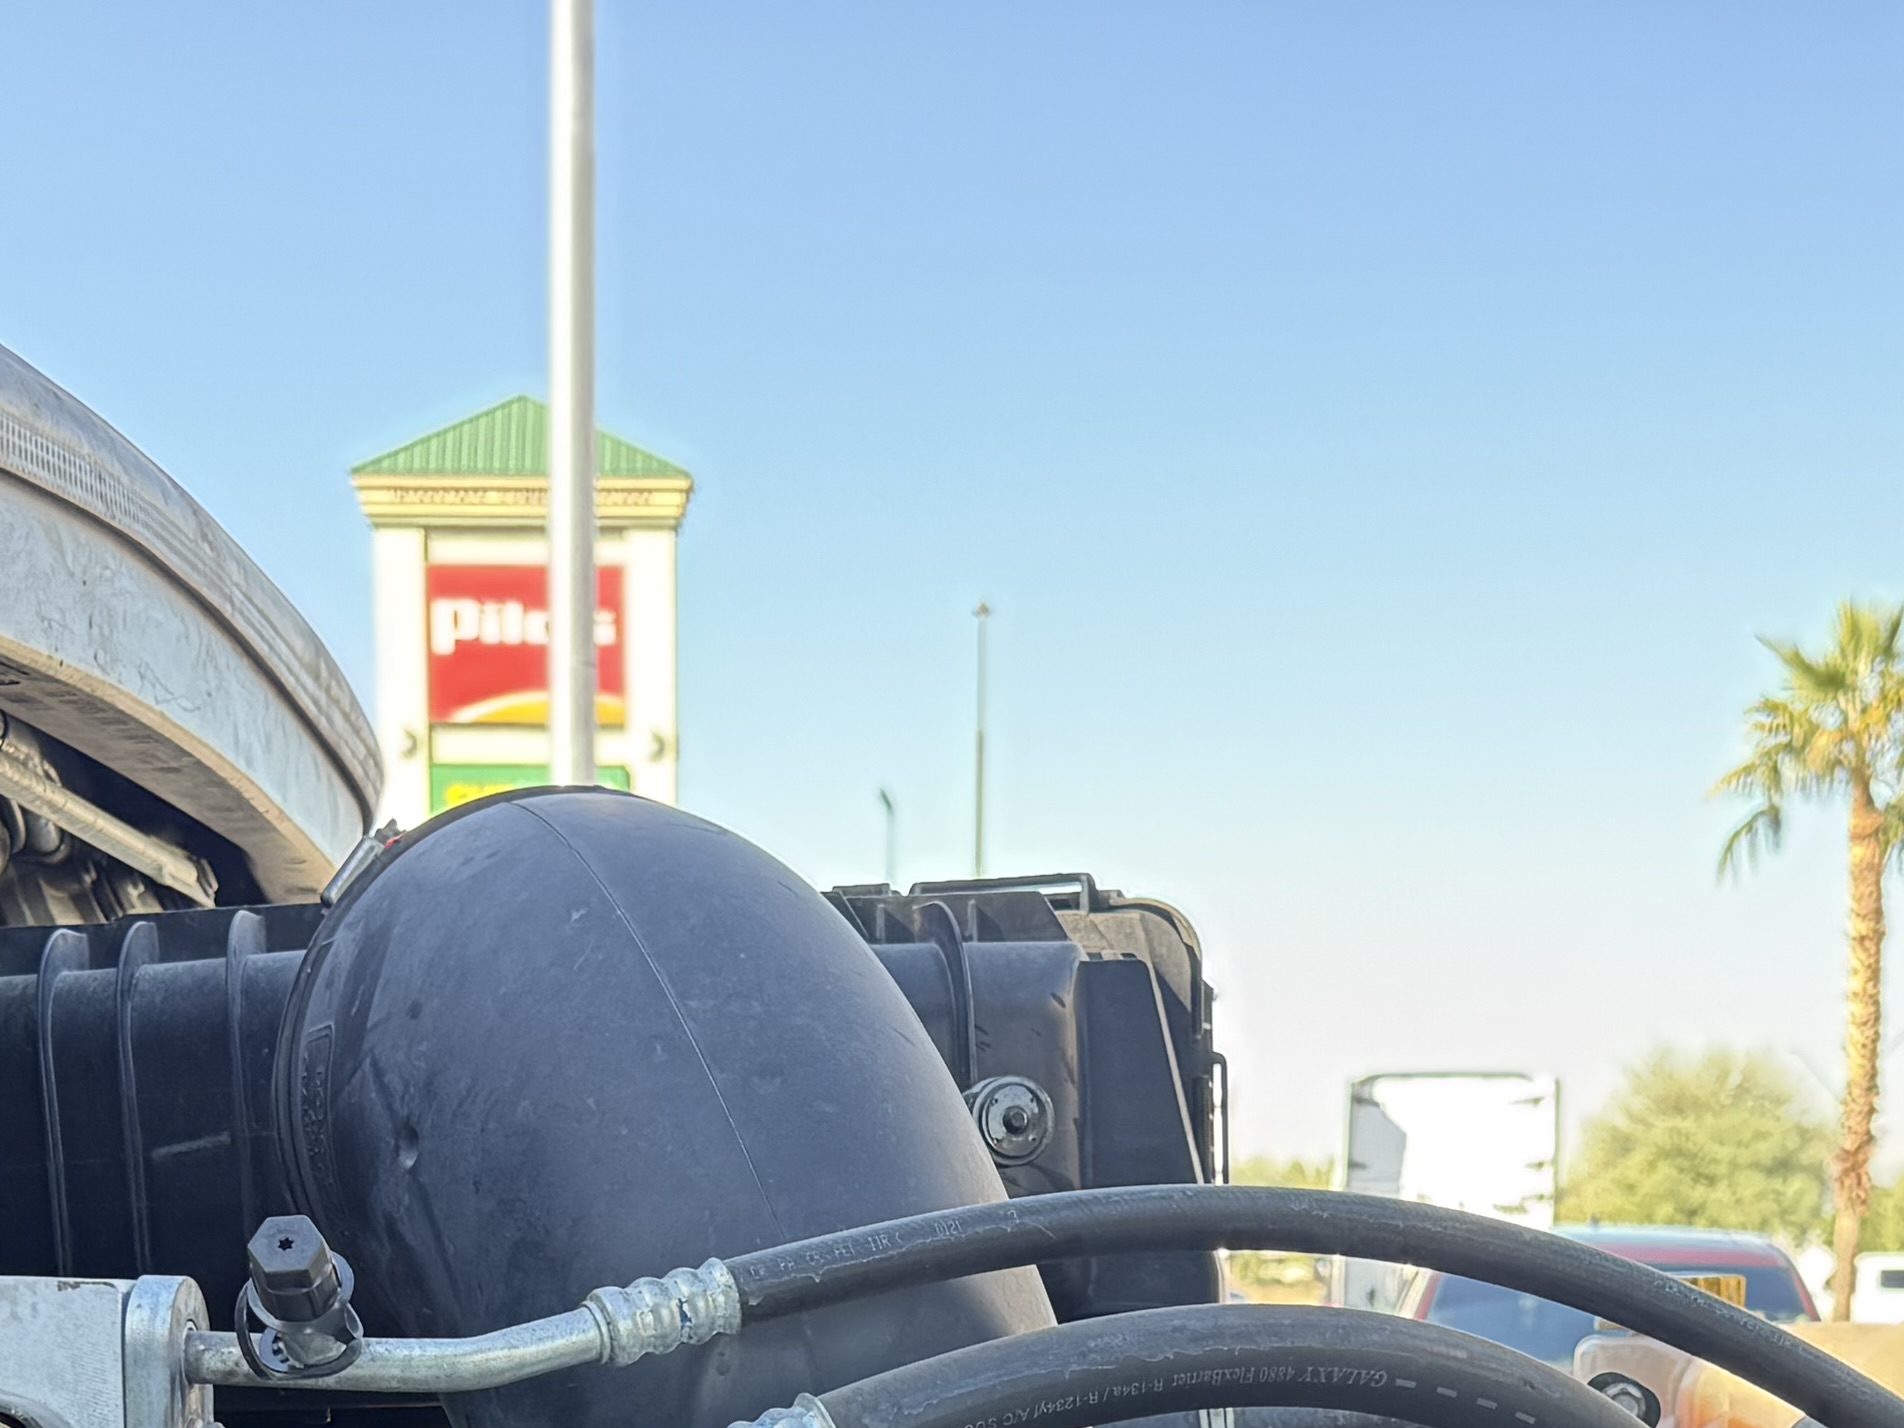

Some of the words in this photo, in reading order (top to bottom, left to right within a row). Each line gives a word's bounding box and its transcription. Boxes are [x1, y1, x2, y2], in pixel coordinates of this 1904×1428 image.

[430, 596, 617, 656] Pil
[1112, 1377, 1165, 1397] R-134a
[1297, 1365, 1388, 1389] GALAXY
[1002, 1407, 1031, 1427] A/C
[1033, 1390, 1104, 1420] R-1234yf
